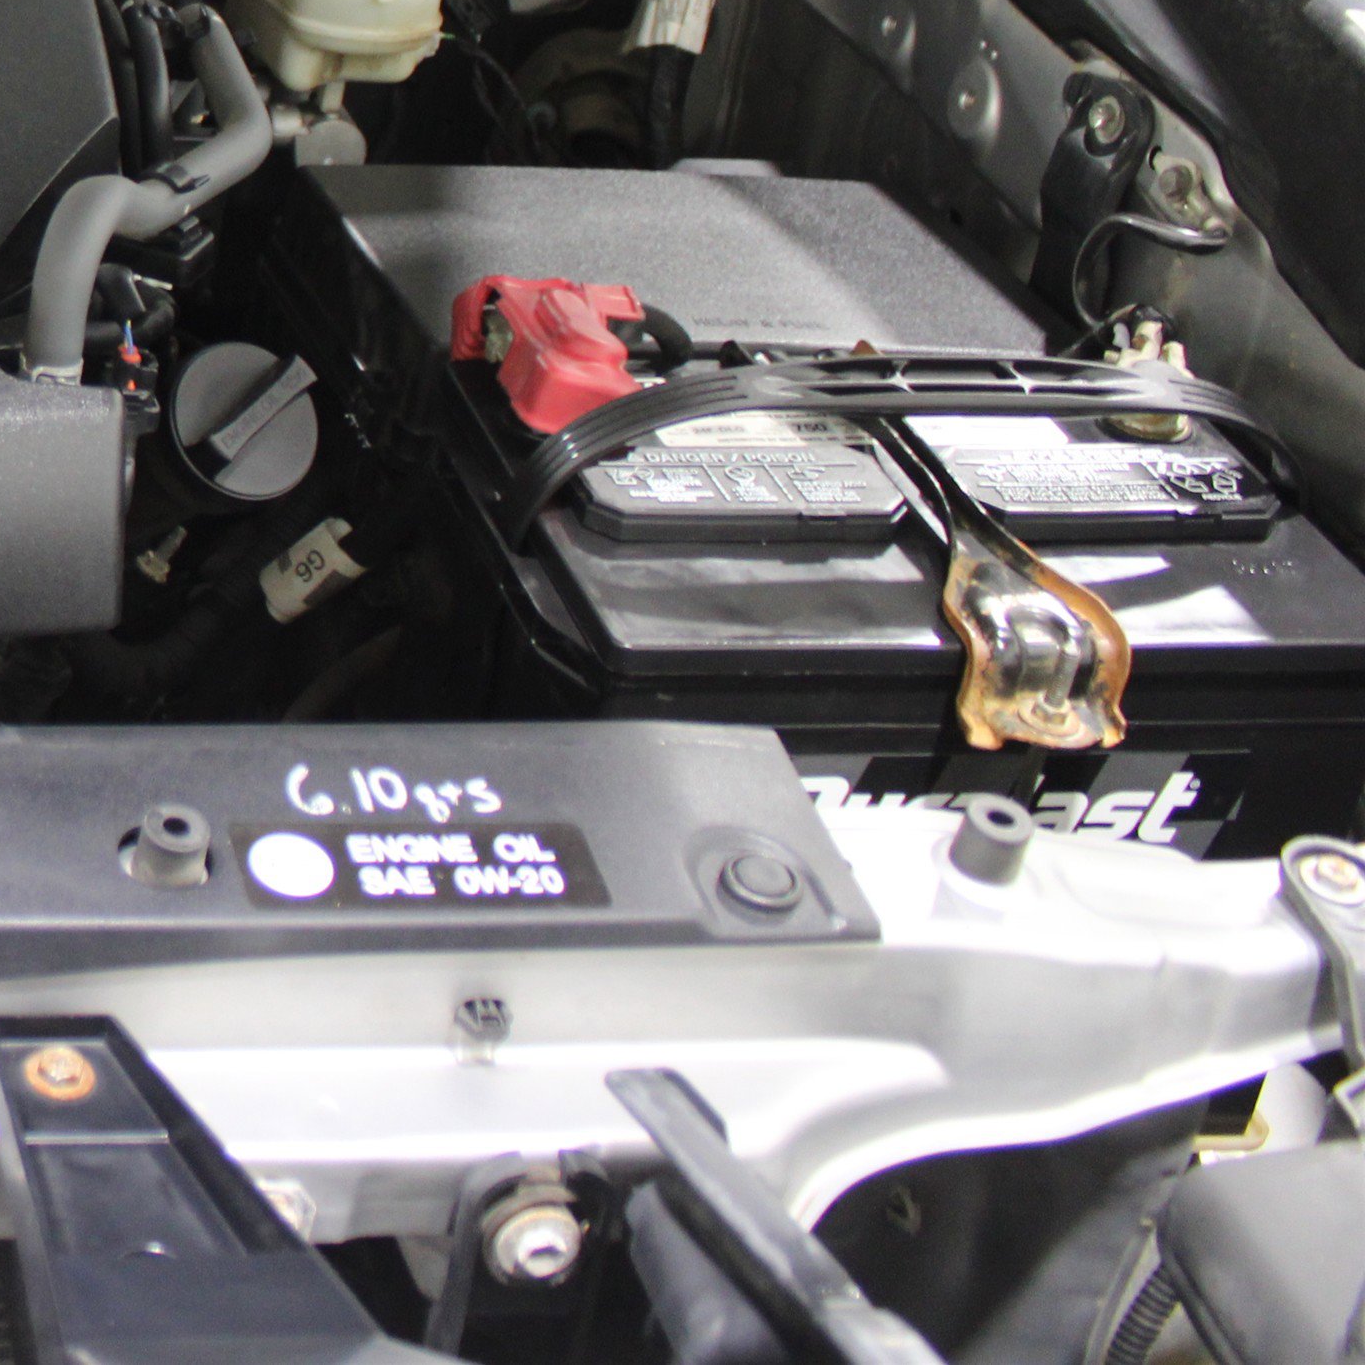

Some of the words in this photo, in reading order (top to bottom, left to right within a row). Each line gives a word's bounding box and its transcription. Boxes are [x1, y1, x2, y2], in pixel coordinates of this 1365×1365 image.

[644, 451, 728, 463] DANGER
[742, 451, 816, 464] POISON
[345, 833, 479, 864] ENGINE
[492, 833, 557, 864] OIL
[358, 865, 437, 896] SAE
